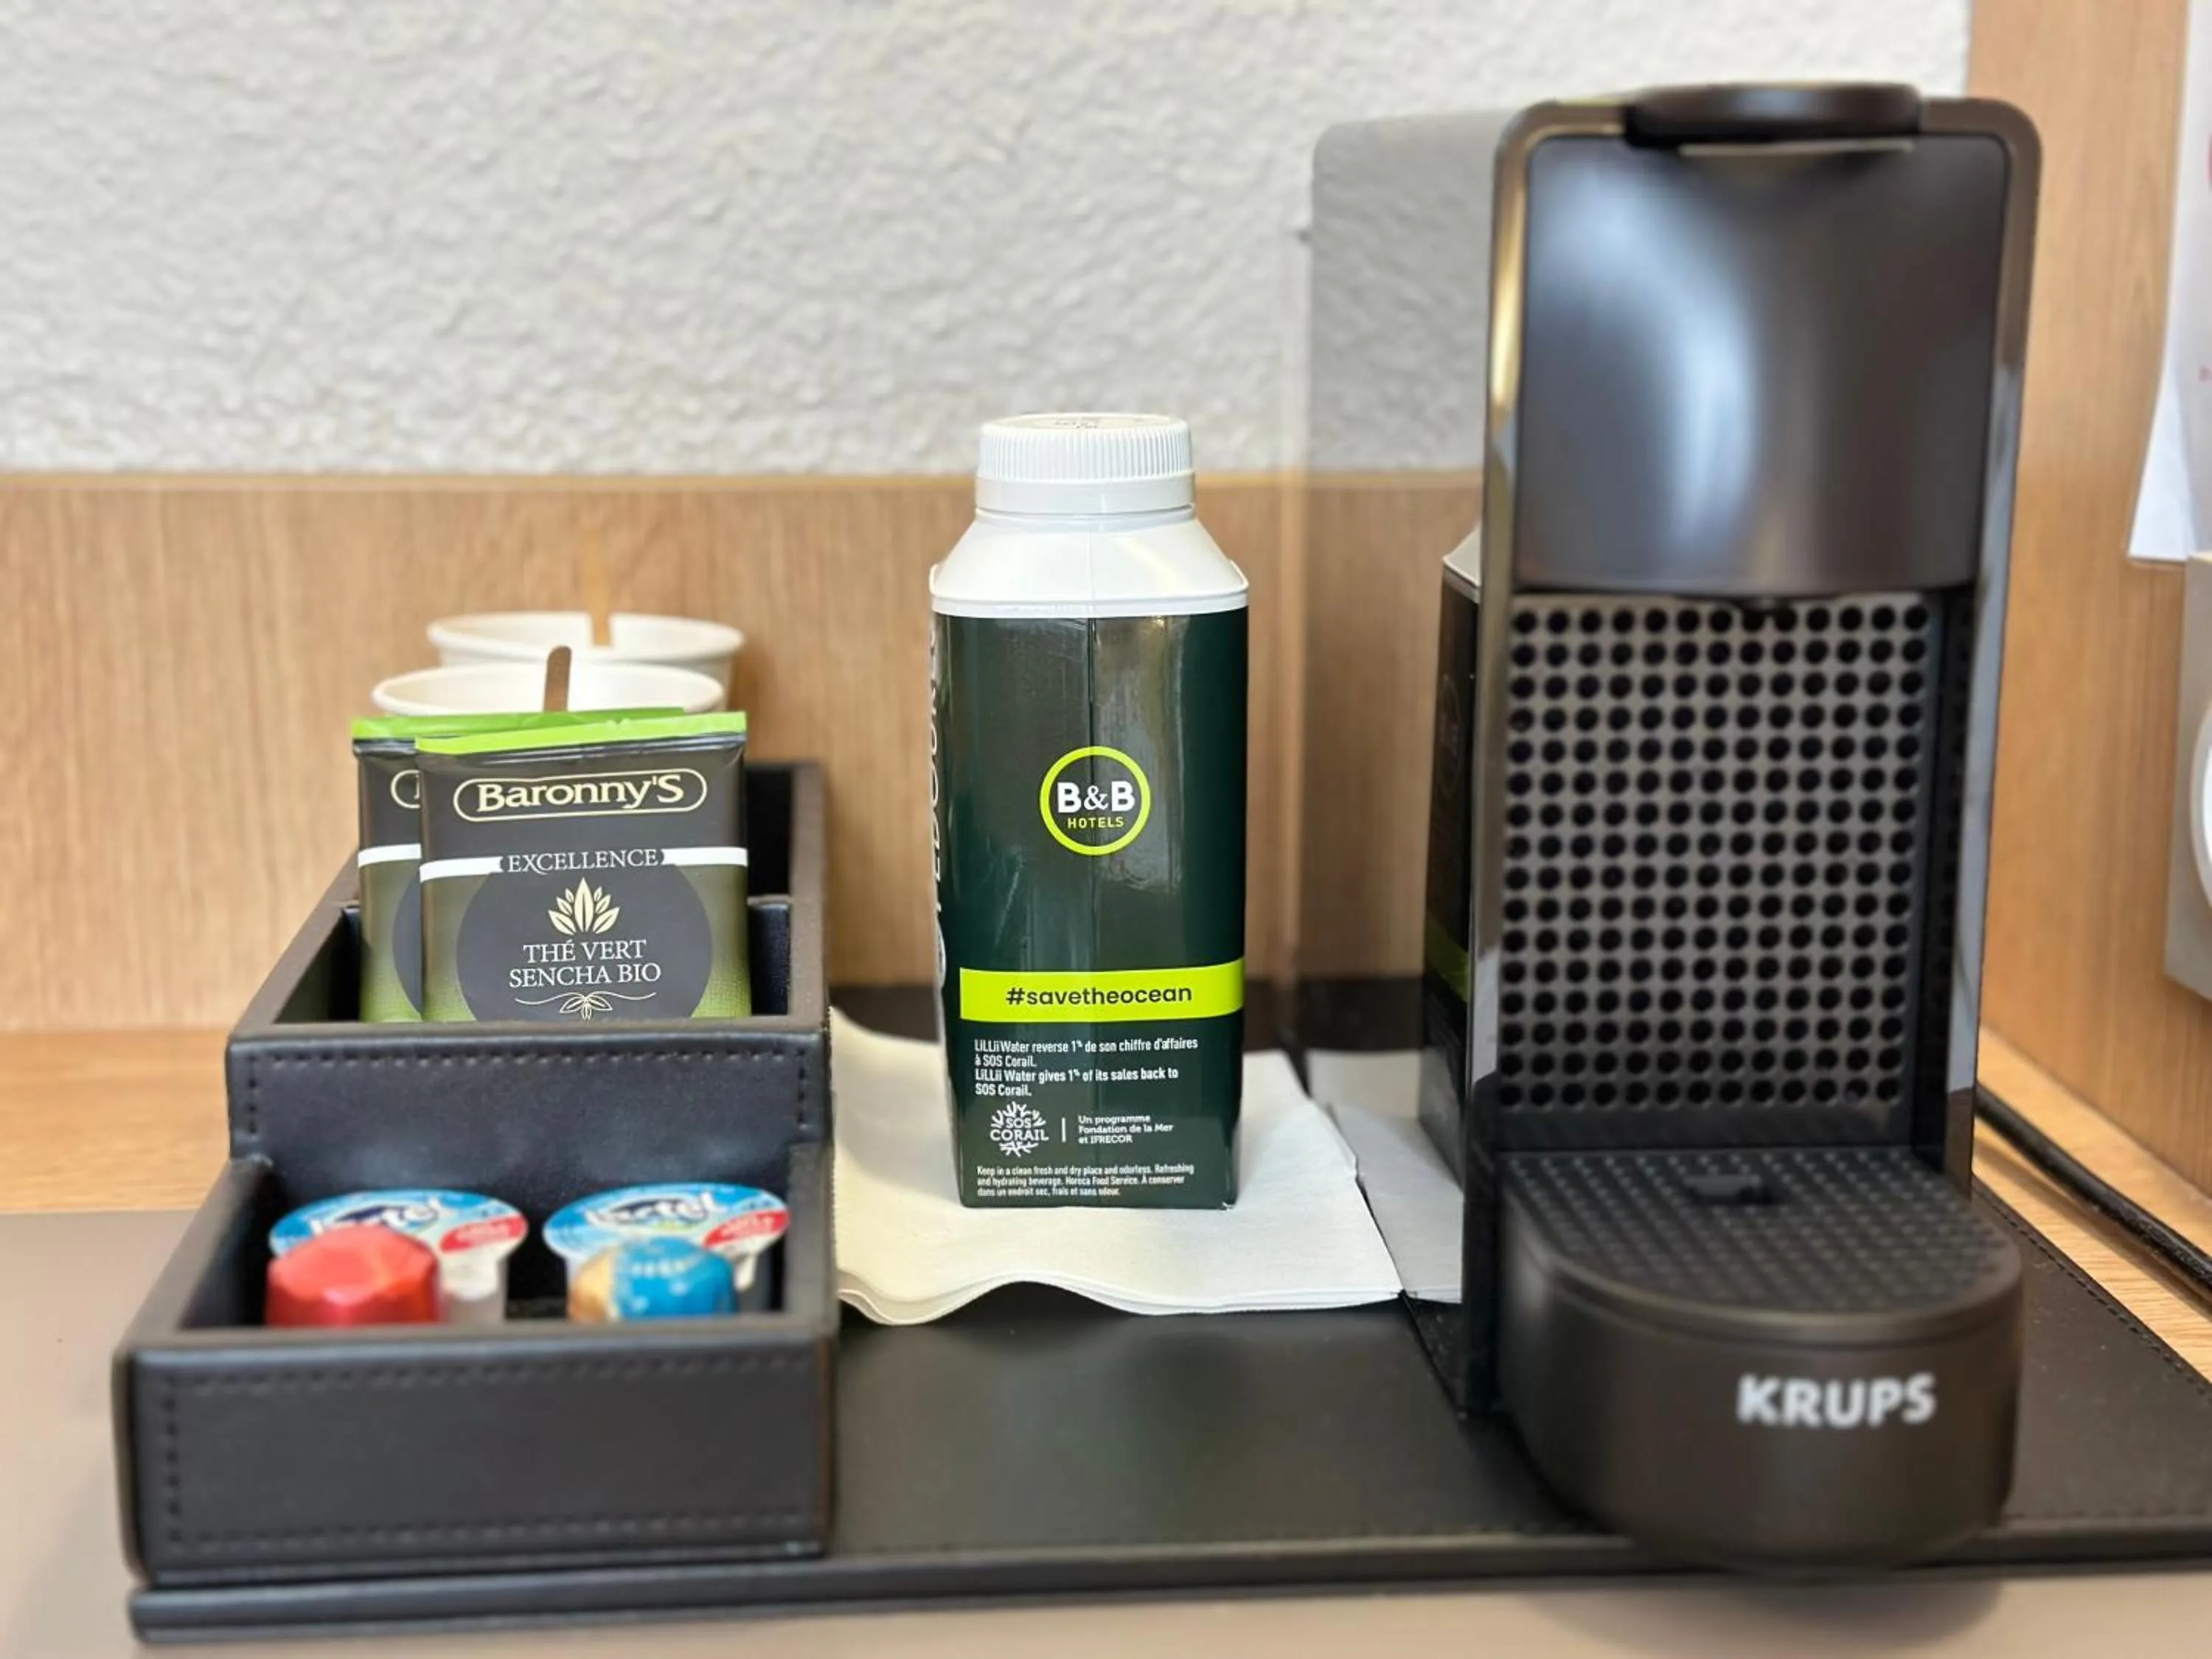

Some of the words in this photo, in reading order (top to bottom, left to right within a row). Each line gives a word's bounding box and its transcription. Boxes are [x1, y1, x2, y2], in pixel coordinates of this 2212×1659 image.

[476, 774, 684, 812] Baronny'S
[1057, 781, 1135, 813] B&B
[1068, 817, 1124, 828] HOTELS
[507, 849, 658, 875] EXCELLENCE
[523, 939, 576, 963] THÉ
[581, 939, 647, 961] VERT
[509, 965, 612, 988] SENCHA
[617, 962, 661, 983] BIO
[1006, 987, 1192, 1005] #savetheocean
[1032, 1043, 1068, 1052] reverse
[1085, 1040, 1096, 1052] de
[1099, 1042, 1117, 1052] son
[1119, 1039, 1151, 1051] chiffre
[1154, 1037, 1198, 1050] d'affaires
[975, 1054, 981, 1066] à
[983, 1055, 1002, 1067] SOS
[1004, 1070, 1035, 1082] Water
[1038, 1070, 1066, 1084] gives
[1082, 1070, 1093, 1081] of
[1095, 1069, 1108, 1081] its
[1110, 1068, 1138, 1080] sales
[1141, 1068, 1166, 1079] back
[1168, 1067, 1178, 1079] to
[975, 1083, 995, 1095] SOS
[1006, 1118, 1031, 1128] SOS
[1078, 1116, 1093, 1124] Un
[1095, 1115, 1150, 1127] programme
[990, 1129, 1049, 1141] CORAIL
[1079, 1124, 1127, 1133] Fondation
[1130, 1124, 1141, 1133] de
[1144, 1124, 1152, 1132] la
[1155, 1124, 1174, 1132] Mer
[977, 1166, 995, 1177] Keep
[1006, 1167, 1011, 1175] a
[1012, 1165, 1032, 1175] clean
[1033, 1165, 1053, 1175] fresh
[1054, 1165, 1068, 1175] and
[1070, 1165, 1082, 1176] dry
[1083, 1165, 1102, 1176] place
[1105, 1165, 1118, 1175] and
[977, 1178, 991, 1186] and
[992, 1177, 1026, 1188] hydrating
[1092, 1176, 1109, 1185] Food
[977, 1188, 995, 1196] dans
[1052, 1187, 1068, 1195] frais
[1070, 1187, 1077, 1195] et
[1737, 1371, 1938, 1429] KRUPS
